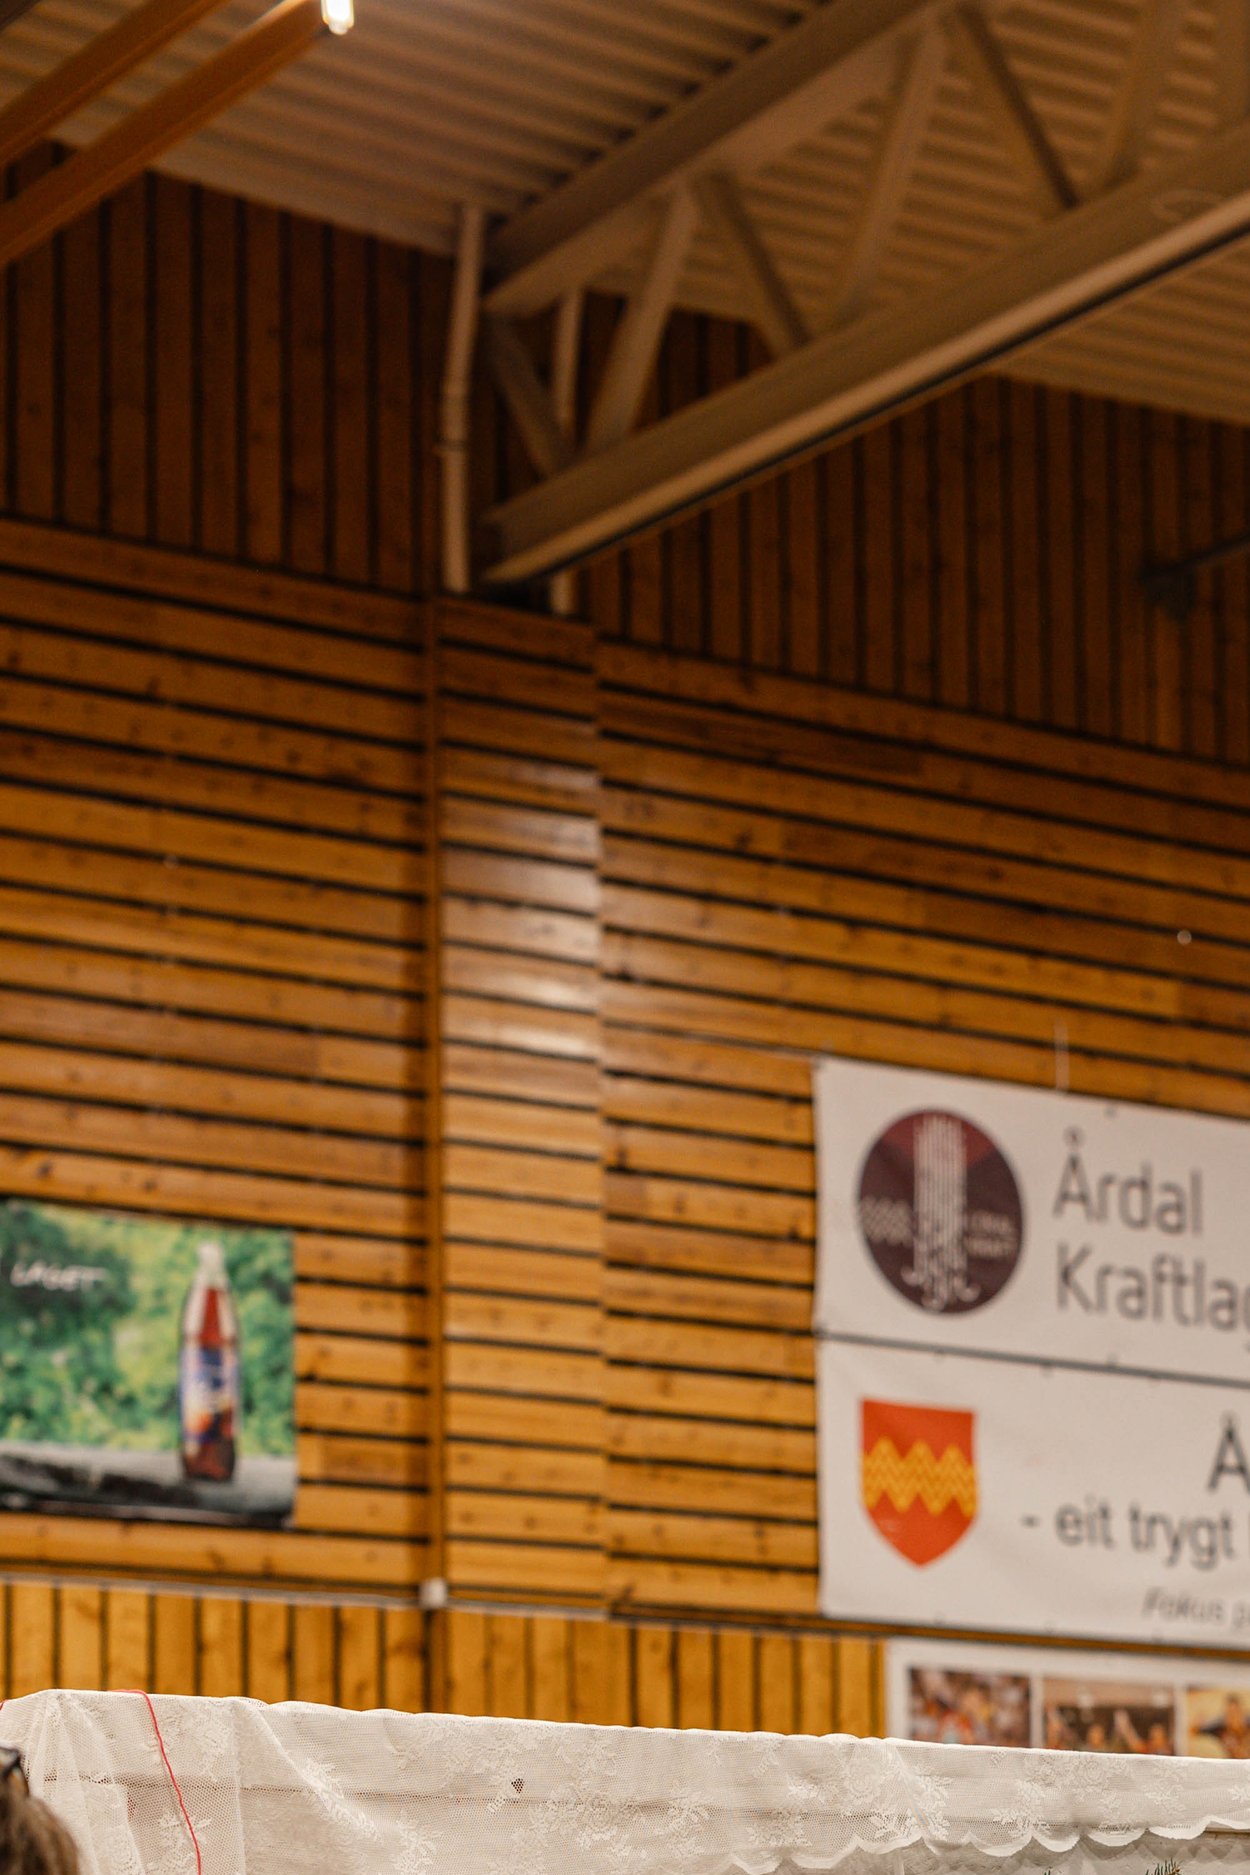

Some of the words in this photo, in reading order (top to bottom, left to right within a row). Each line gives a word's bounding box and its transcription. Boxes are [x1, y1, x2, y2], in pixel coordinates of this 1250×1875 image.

[1053, 1126, 1204, 1236] Årdal
[1055, 1496, 1114, 1550] eit
[1128, 1502, 1235, 1571] trygt
